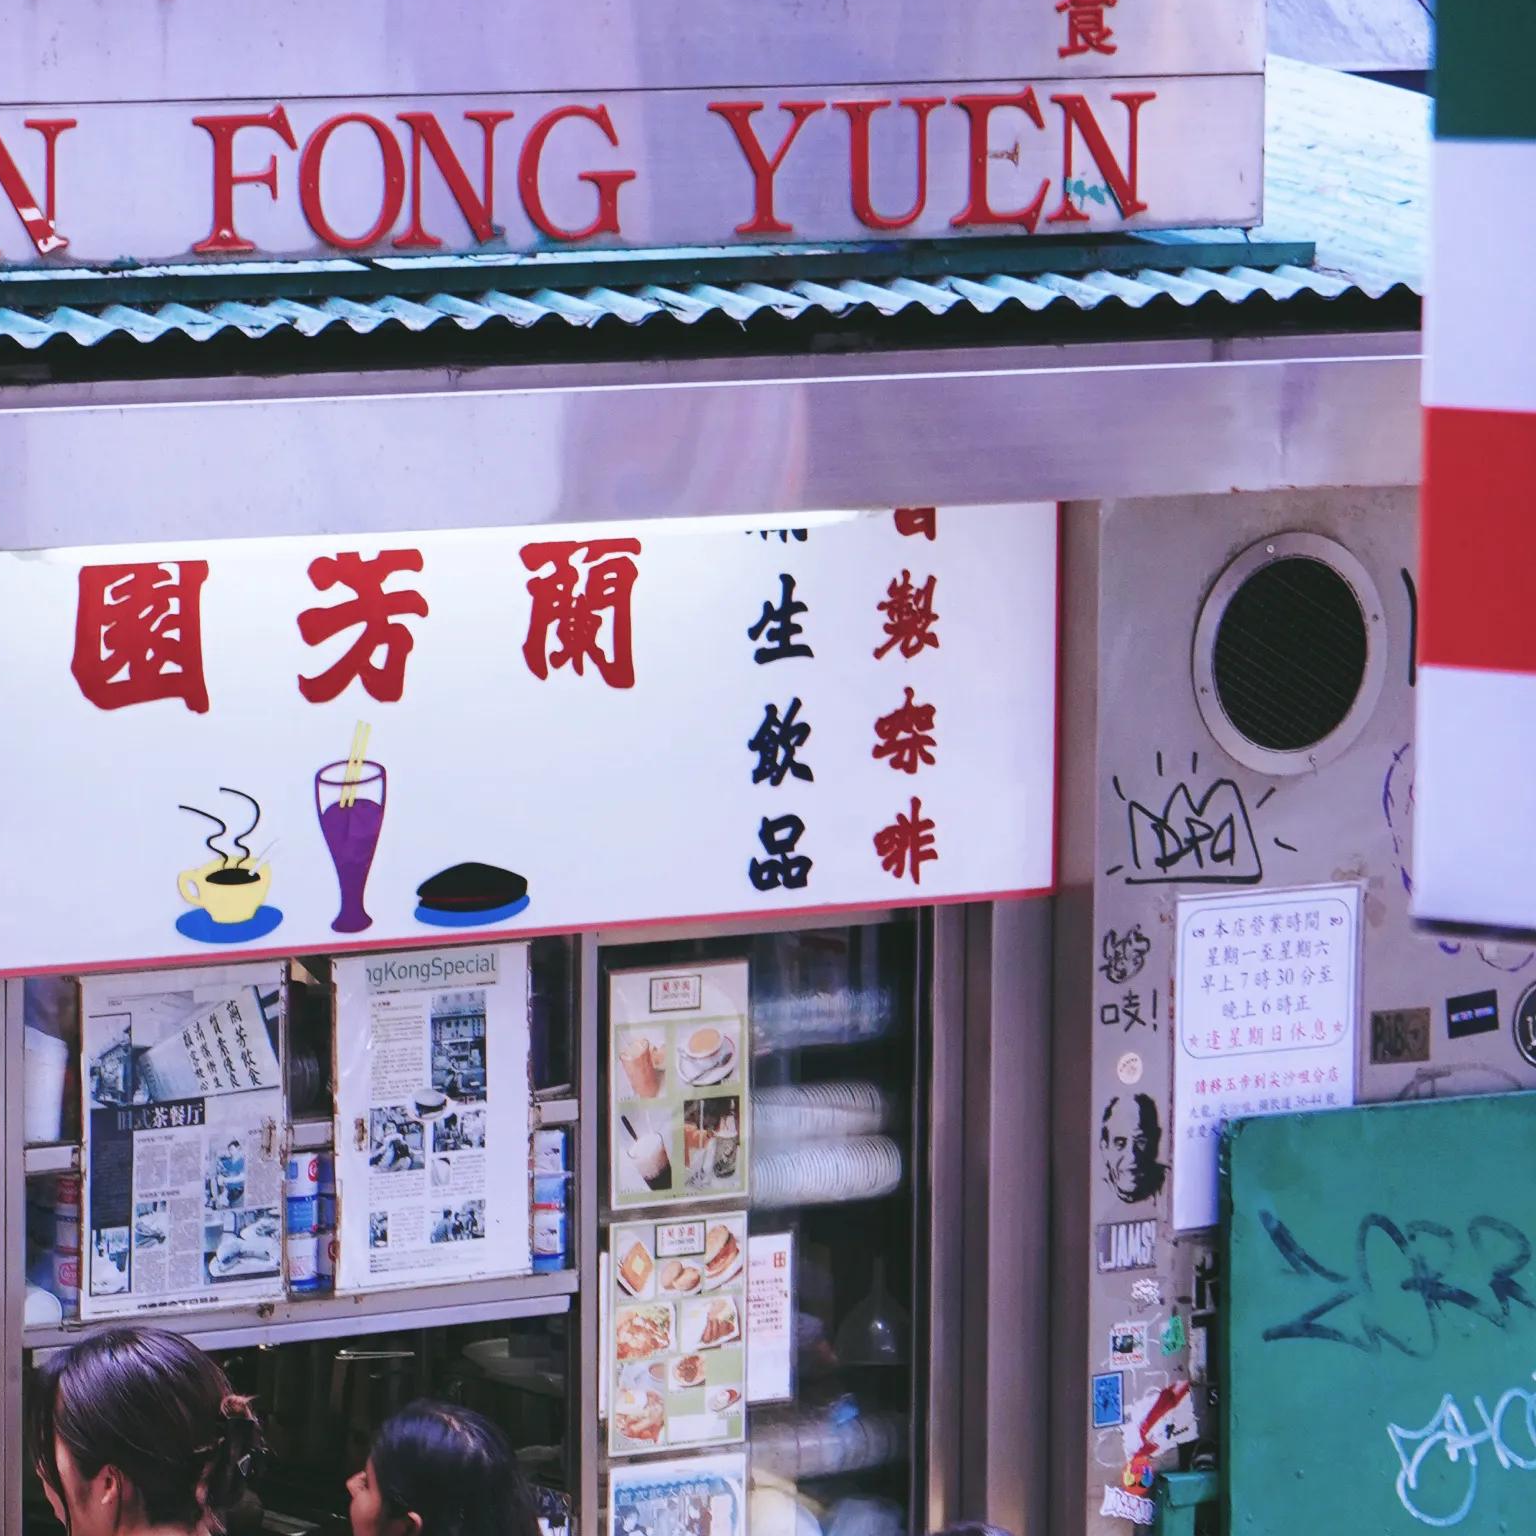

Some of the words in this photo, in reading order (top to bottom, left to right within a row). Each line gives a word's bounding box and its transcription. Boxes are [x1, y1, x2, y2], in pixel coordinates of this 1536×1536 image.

[192, 103, 638, 253] FONG
[707, 85, 1157, 236] YUEN
[746, 528, 815, 891] 生飲品
[1207, 939, 1330, 968] 星期一至星期六
[1214, 910, 1321, 937] 本店營業時間
